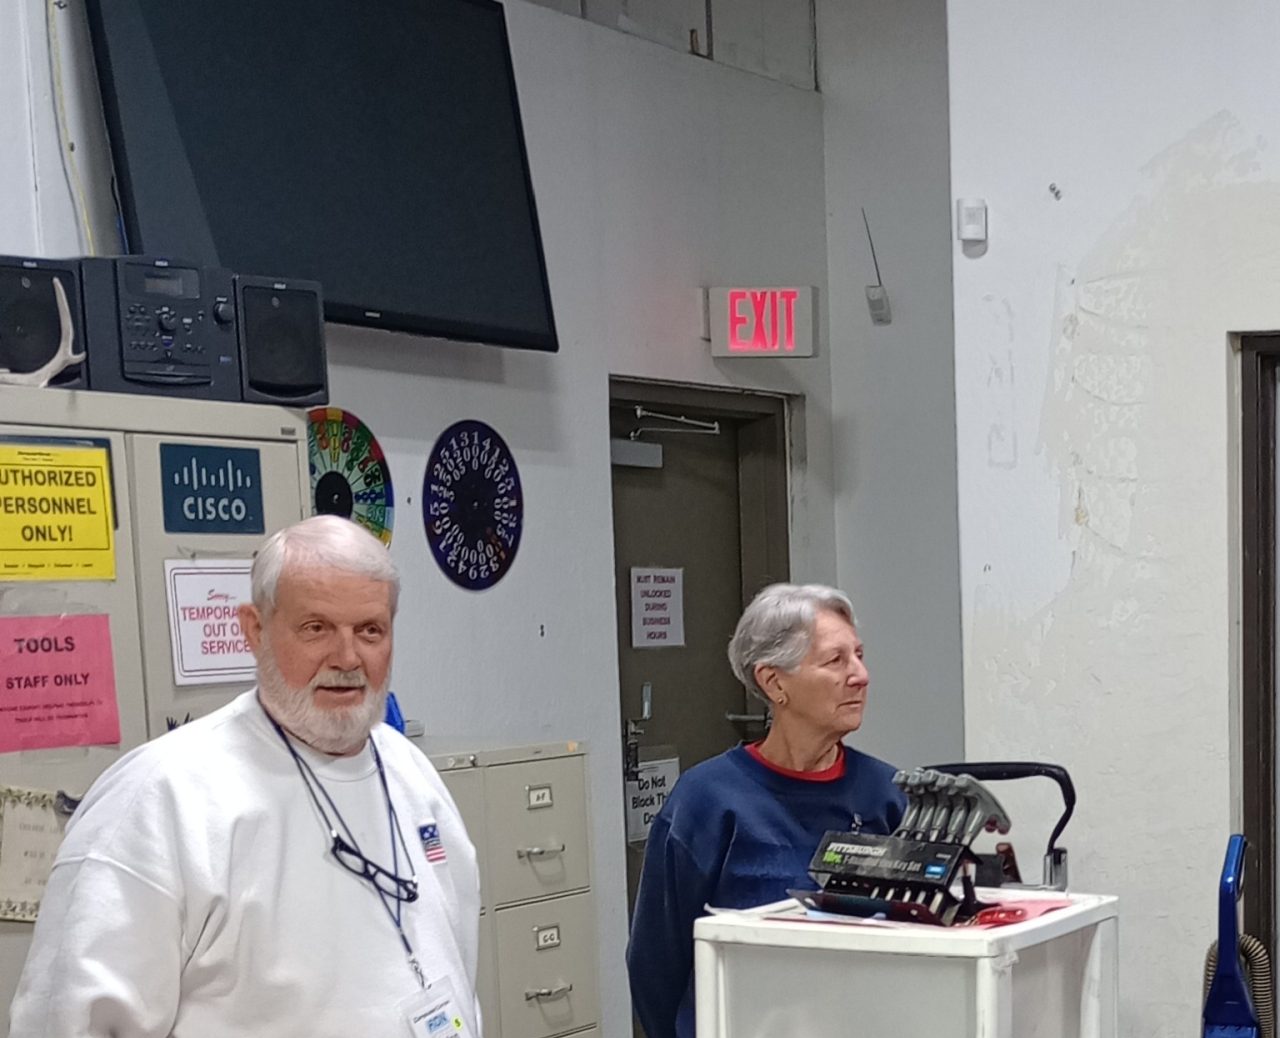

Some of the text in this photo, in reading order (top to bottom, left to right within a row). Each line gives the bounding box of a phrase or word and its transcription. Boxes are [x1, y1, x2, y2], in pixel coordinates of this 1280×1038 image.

[728, 289, 798, 351] EXIT
[0, 468, 96, 487] UTHORIZED
[0, 496, 97, 515] ERSONNEL
[183, 496, 246, 520] CISCO
[21, 525, 73, 542] ONLY!
[180, 606, 239, 621] TEMPORA
[203, 622, 243, 637] OUT O
[14, 636, 75, 653] TOOLS
[6, 673, 90, 690] STAFF ONLY
